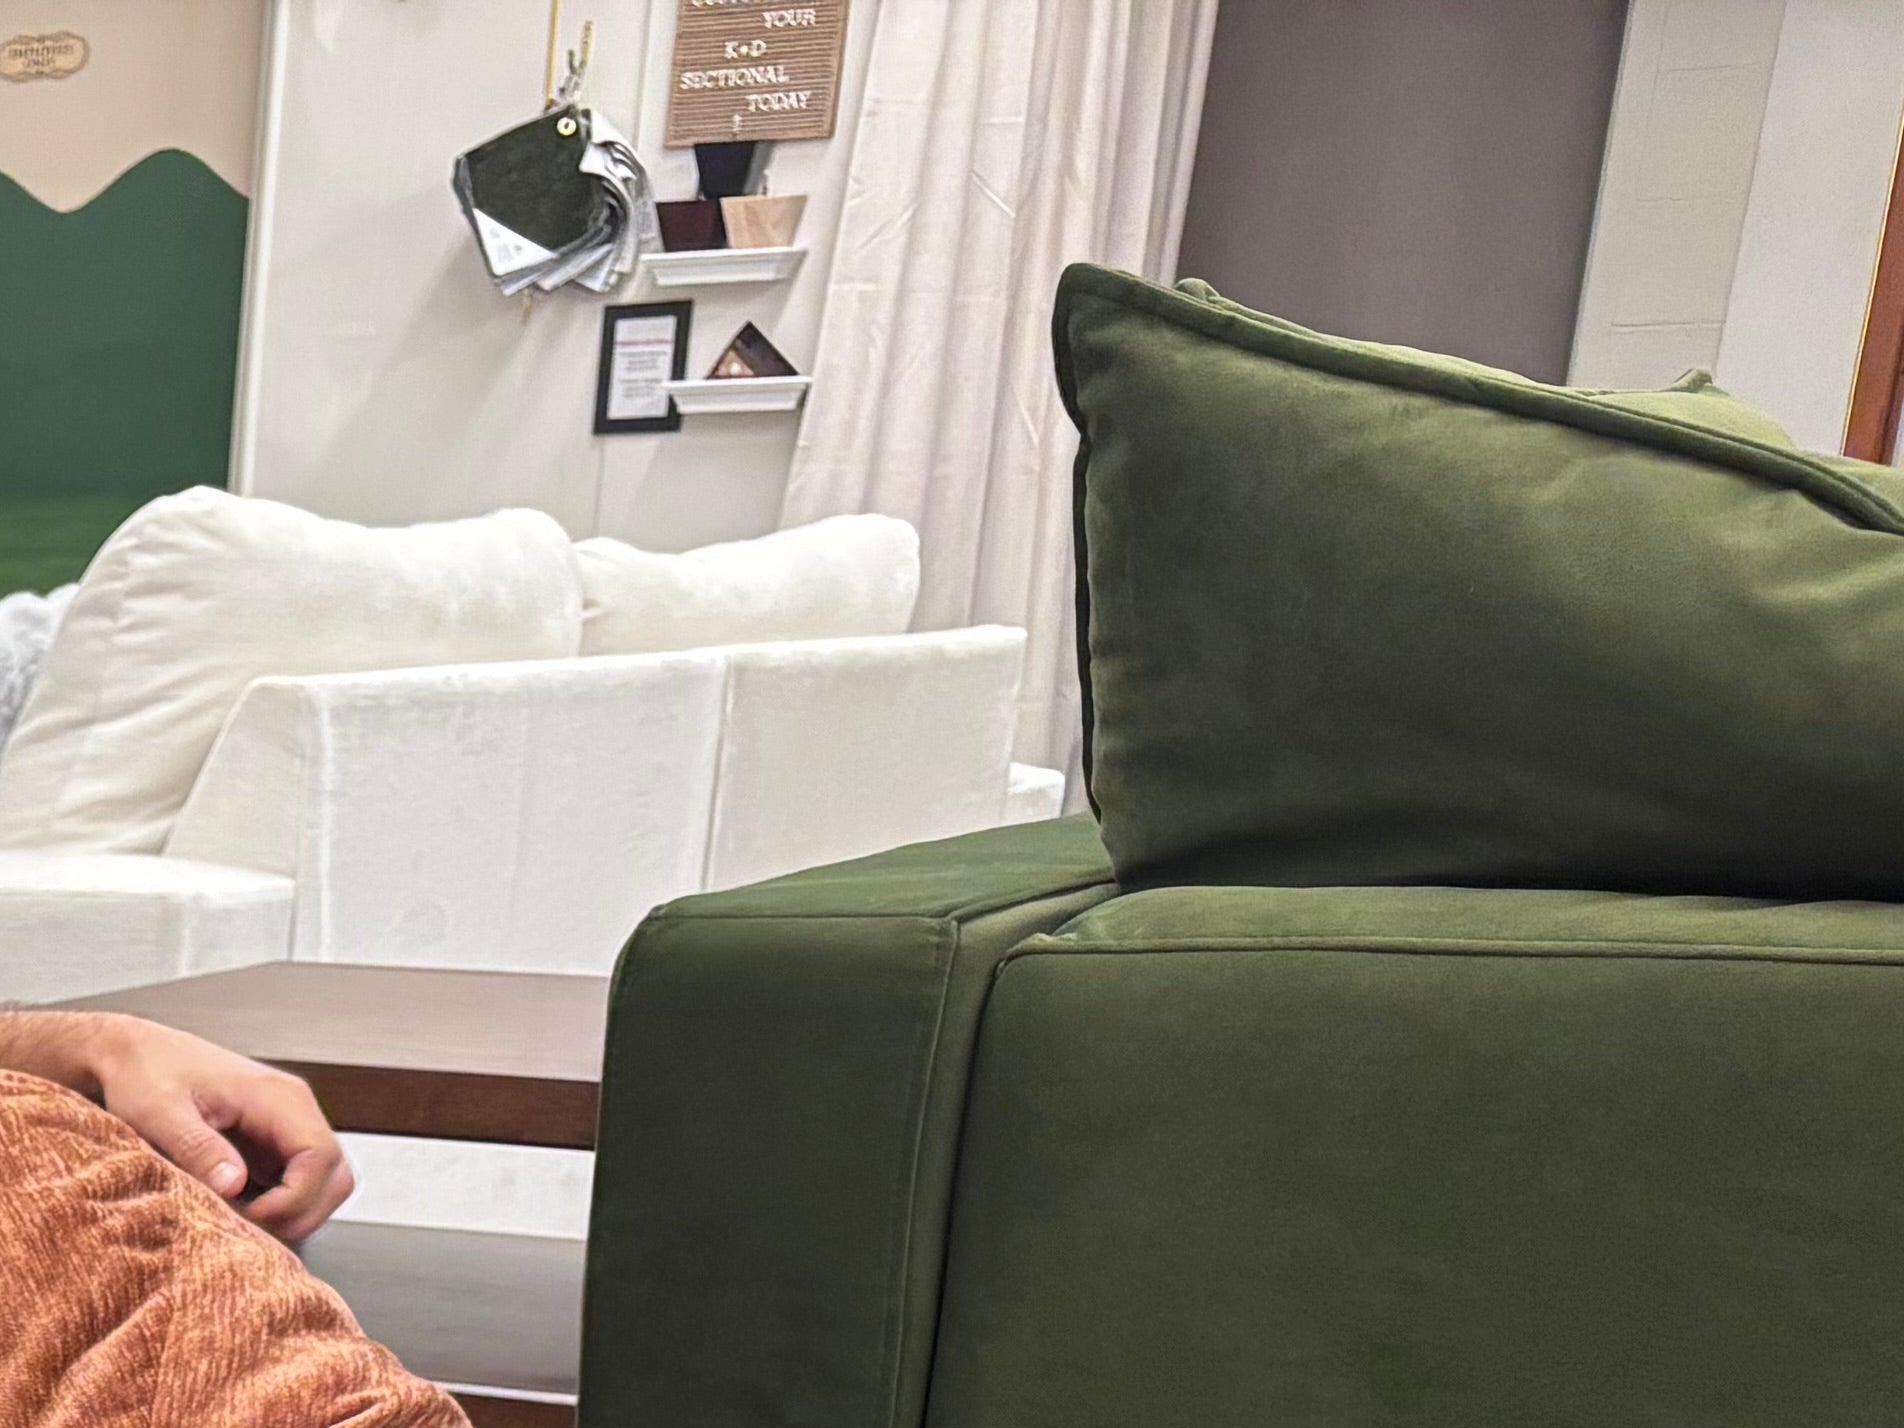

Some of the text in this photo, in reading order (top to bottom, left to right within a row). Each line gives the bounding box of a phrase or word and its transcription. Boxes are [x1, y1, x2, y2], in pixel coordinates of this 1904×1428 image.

[763, 9, 817, 28] YOUR
[680, 65, 791, 90] SECTIONAL
[745, 91, 812, 112] TODAY
